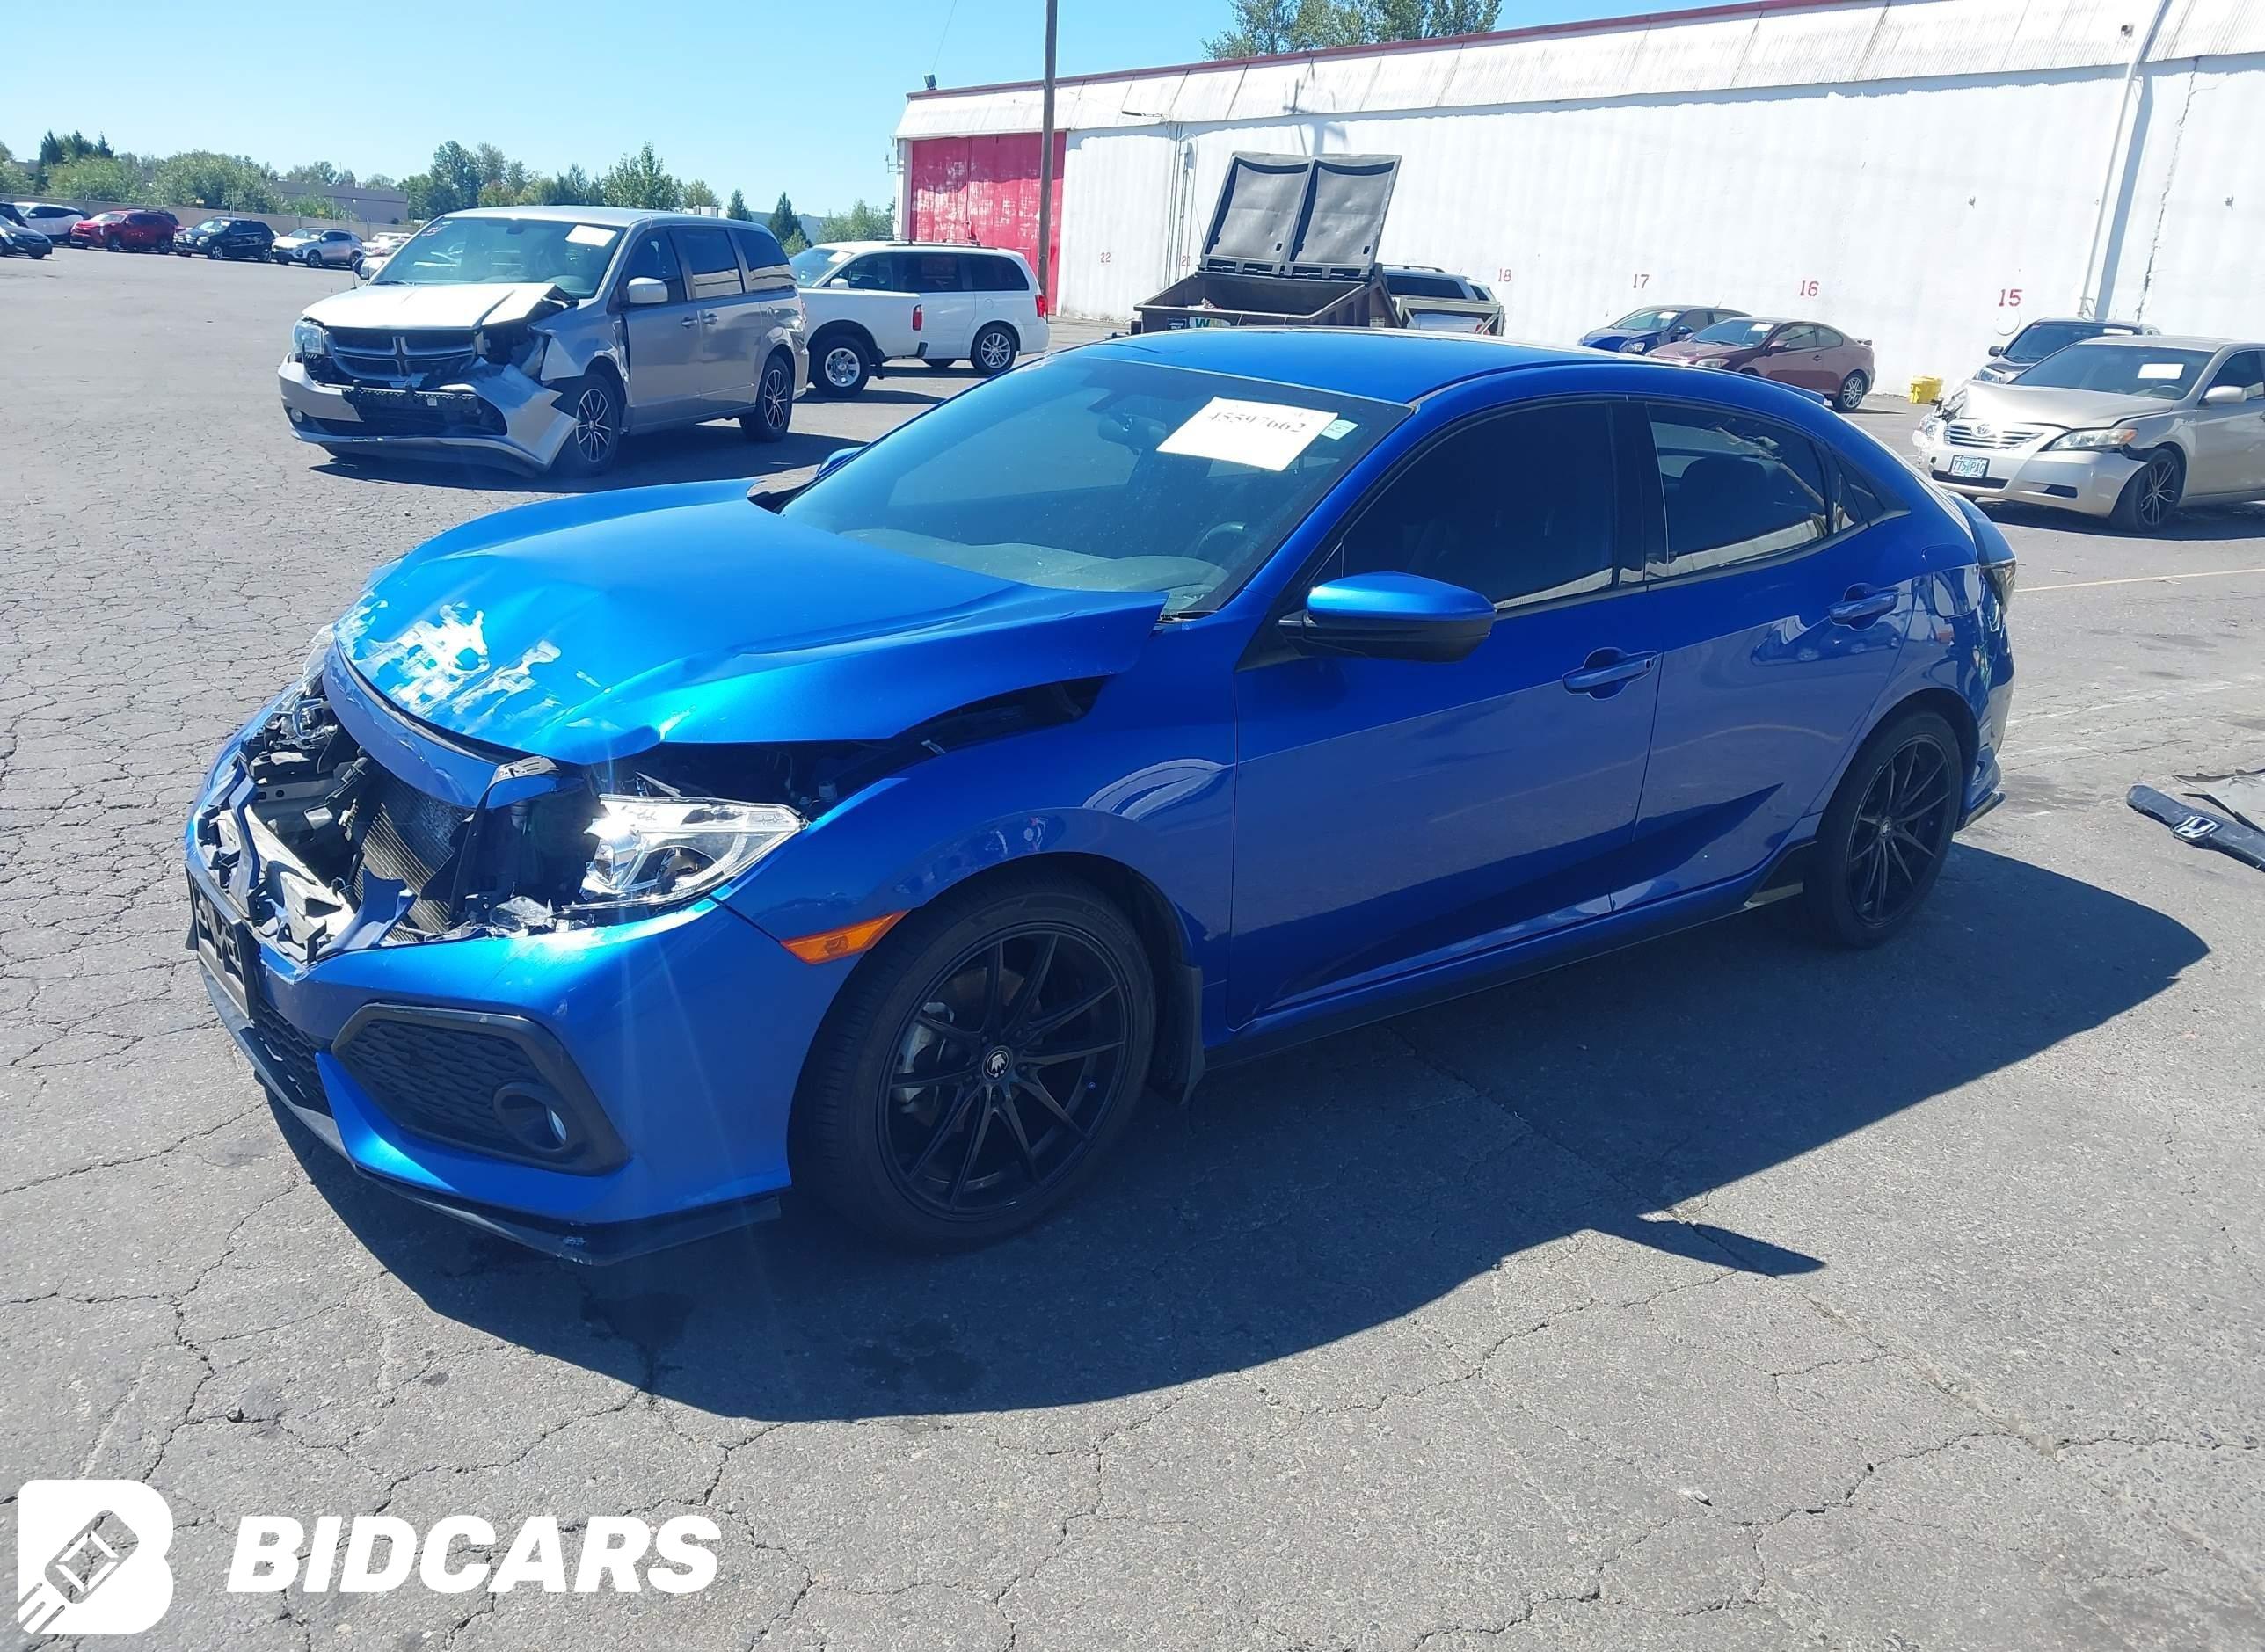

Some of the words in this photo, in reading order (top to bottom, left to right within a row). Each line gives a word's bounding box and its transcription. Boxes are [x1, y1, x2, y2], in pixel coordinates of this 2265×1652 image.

[1100, 252, 1111, 263] 22
[1497, 267, 1512, 282] 18
[1632, 273, 1650, 289] 17
[1799, 280, 1820, 297] 16
[1998, 287, 2023, 307] 15
